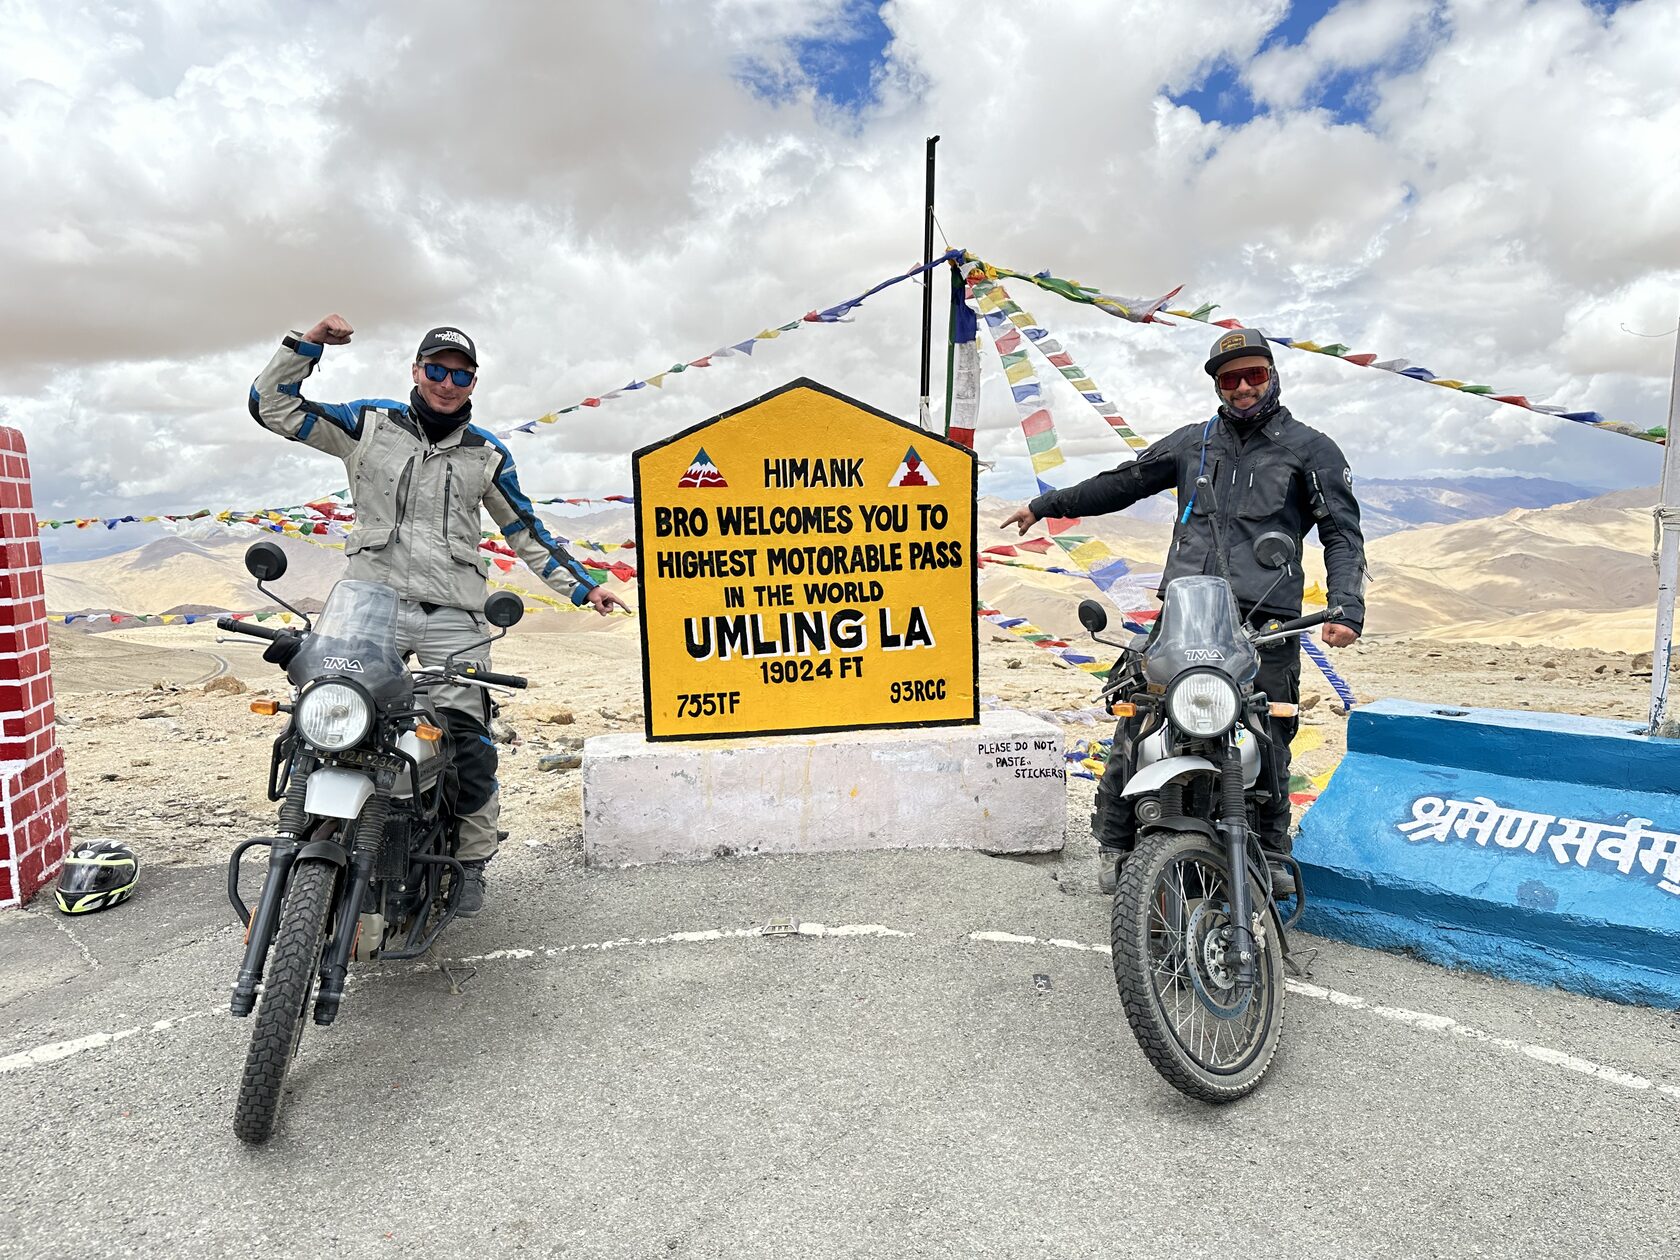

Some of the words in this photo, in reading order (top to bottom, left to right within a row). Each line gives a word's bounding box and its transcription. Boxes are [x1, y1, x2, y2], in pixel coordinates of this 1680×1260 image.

[764, 458, 864, 488] HIMANK
[655, 506, 709, 538] BRO
[717, 505, 853, 536] WELCOMES
[859, 504, 909, 533] YOU
[917, 503, 949, 531] TO
[657, 549, 758, 578] HIGHEST
[767, 543, 902, 576] MOTORABLE
[909, 540, 963, 570] PASS
[724, 587, 745, 608] IN
[753, 584, 794, 607] THE
[804, 580, 884, 604] WORLD
[684, 609, 868, 662] UMLING
[879, 606, 936, 652] LA
[760, 659, 833, 684] 19024
[840, 656, 864, 679] FT
[677, 691, 740, 718] 755TF
[890, 679, 946, 704] 93RCC
[978, 742, 1011, 755] PLEASE
[1015, 741, 1028, 752] DO
